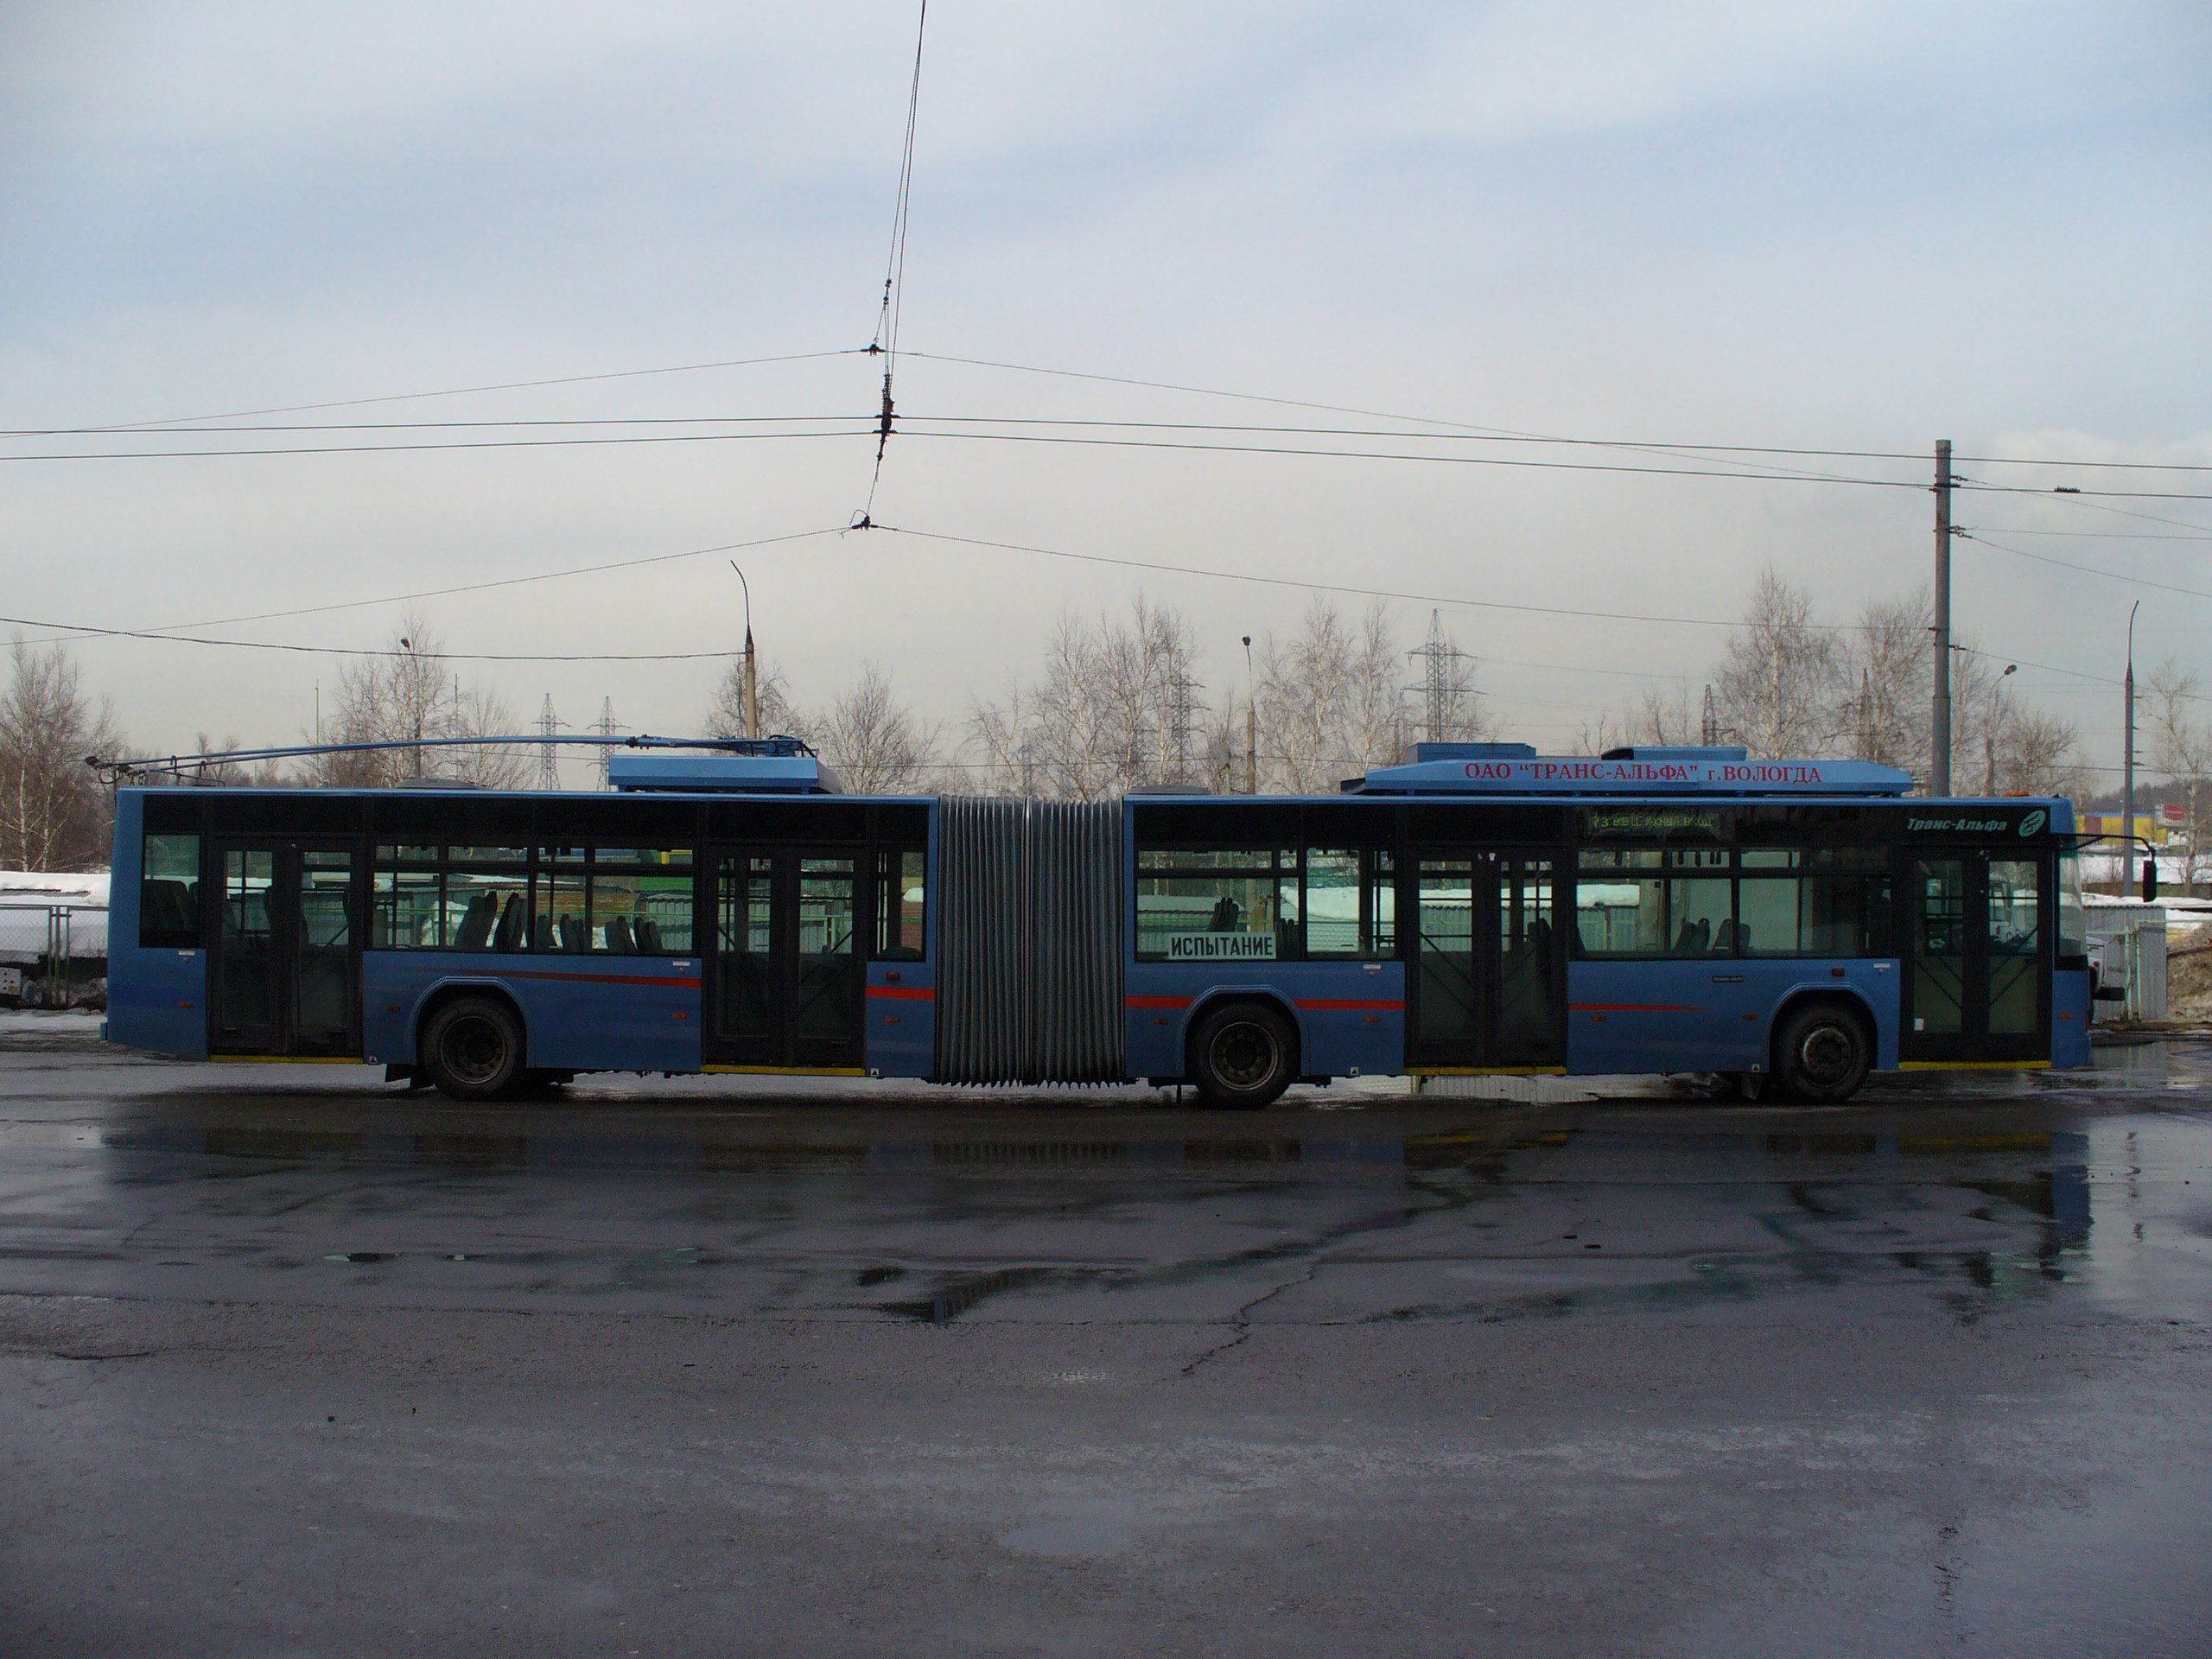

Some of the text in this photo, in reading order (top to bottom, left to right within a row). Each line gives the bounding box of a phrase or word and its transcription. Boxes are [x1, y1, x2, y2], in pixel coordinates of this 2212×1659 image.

[1465, 762, 1512, 779] ОАО
[1906, 817, 2008, 833] Транс-Альфа
[1171, 937, 1273, 956] ИСПЫТАНИЕ
